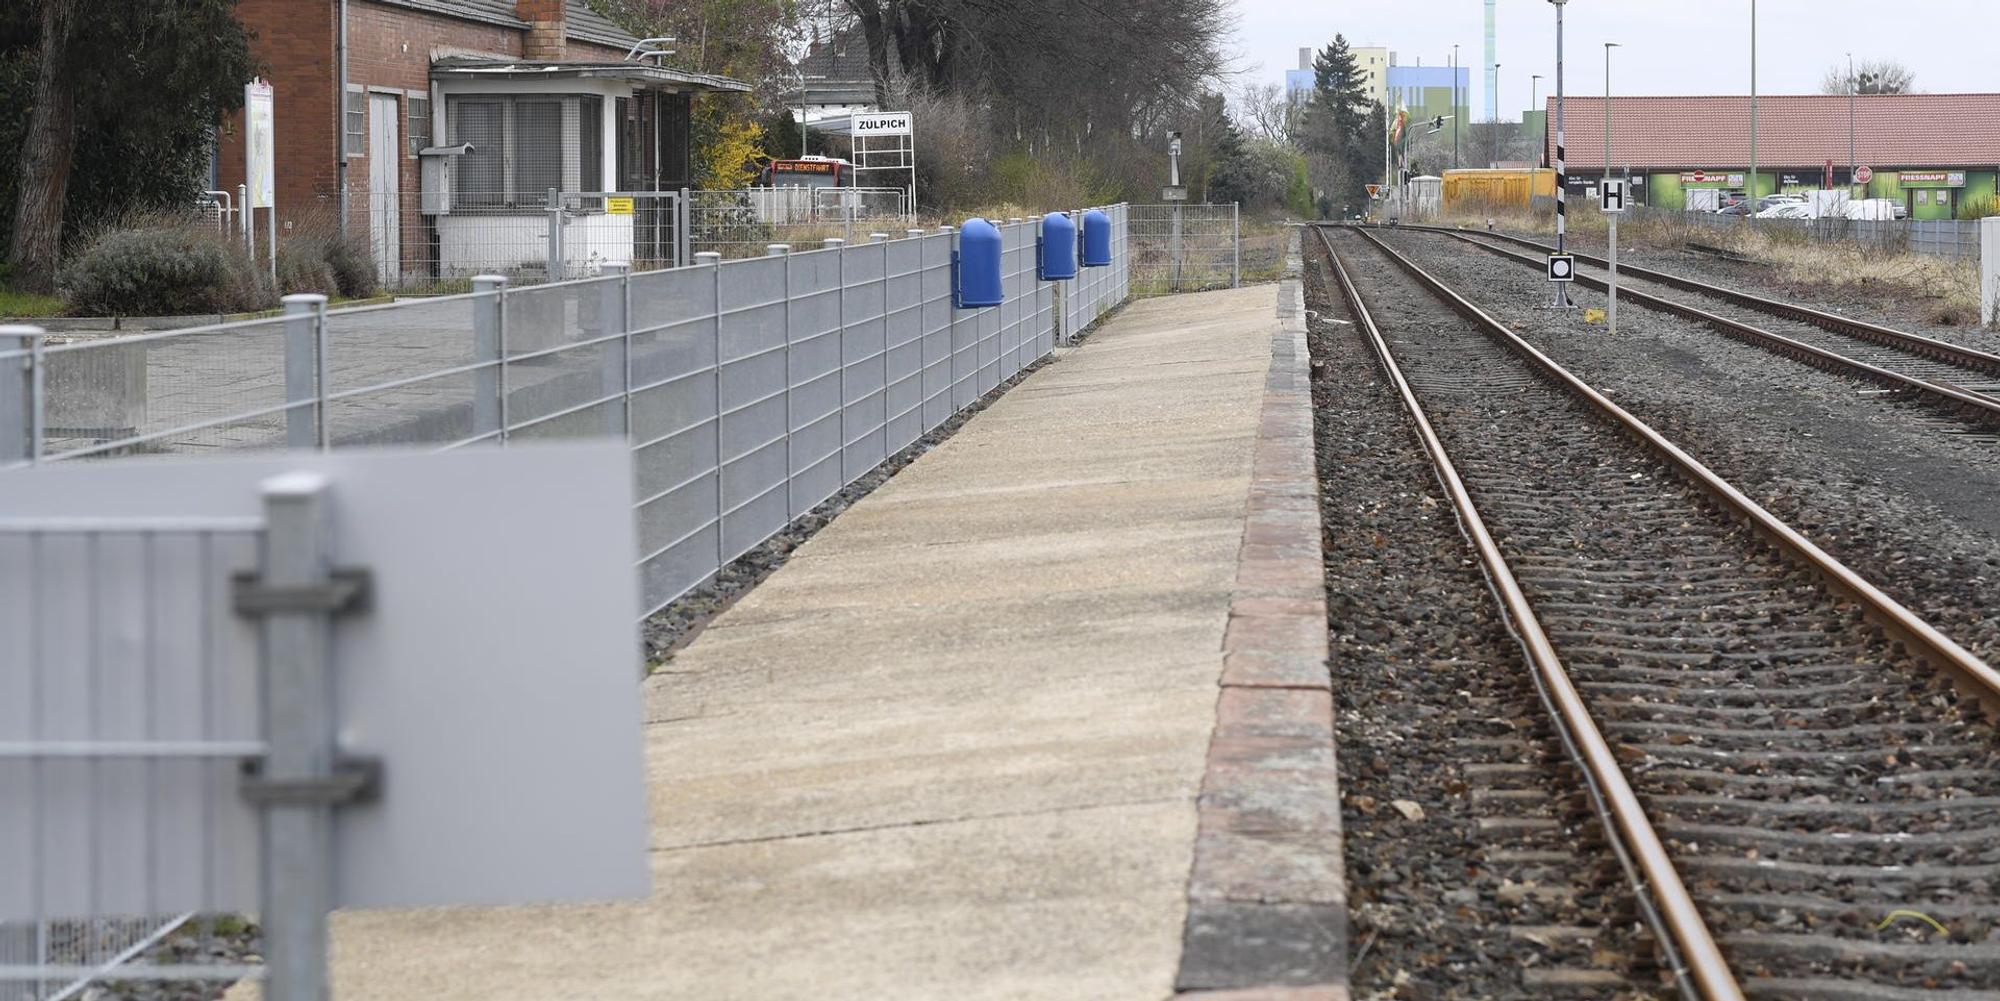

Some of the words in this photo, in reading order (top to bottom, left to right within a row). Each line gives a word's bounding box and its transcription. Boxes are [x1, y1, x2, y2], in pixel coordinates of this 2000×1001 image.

[859, 119, 906, 129] ZÜLPICH
[1857, 171, 1870, 179] STOP
[1603, 182, 1623, 209] H
